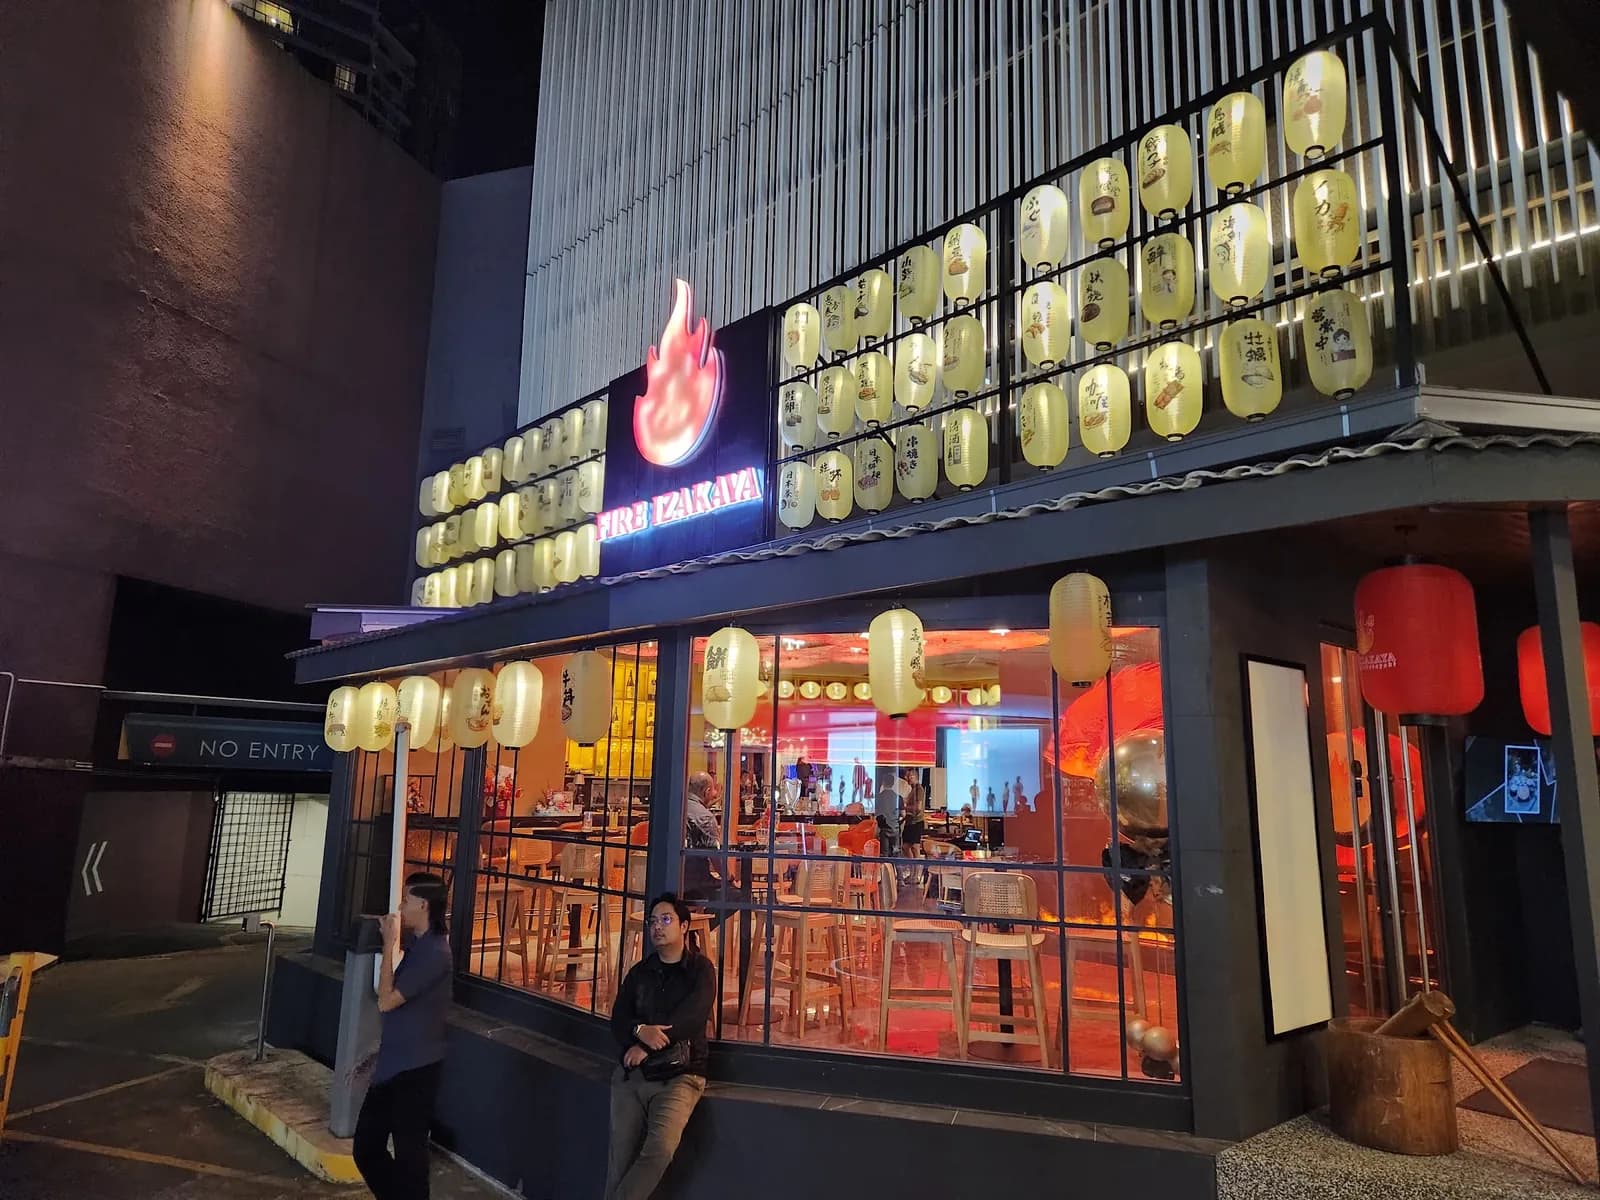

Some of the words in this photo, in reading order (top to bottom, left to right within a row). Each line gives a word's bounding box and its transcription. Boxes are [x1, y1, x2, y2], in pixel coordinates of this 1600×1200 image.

[1311, 306, 1336, 351] 営業中
[596, 500, 648, 541] FIRE
[652, 467, 763, 526] IZAKAYA
[562, 669, 575, 707] 牛丼
[200, 740, 239, 758] NO
[249, 743, 320, 761] ENTRY
